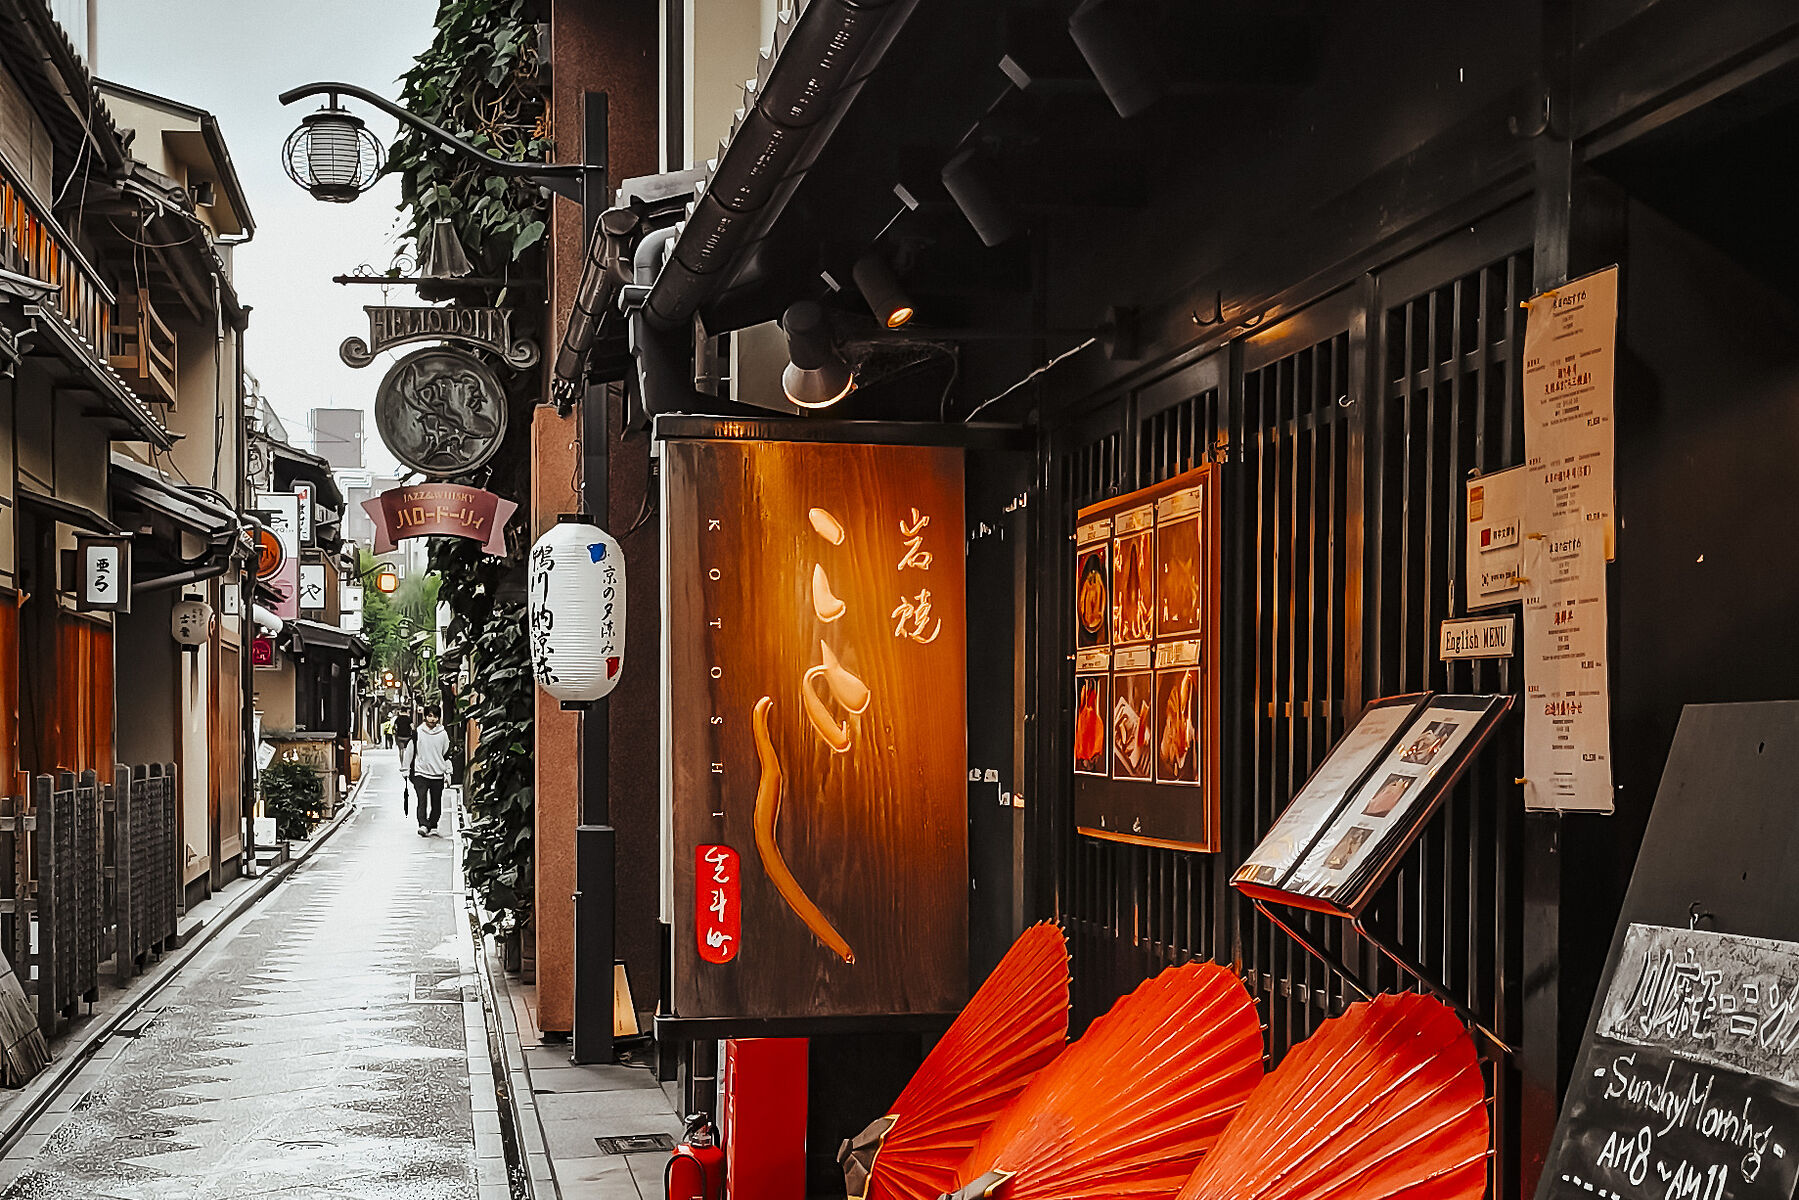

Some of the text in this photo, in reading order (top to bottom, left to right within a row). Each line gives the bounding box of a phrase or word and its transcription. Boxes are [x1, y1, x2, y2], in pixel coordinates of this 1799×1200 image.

[708, 518, 725, 818] KOTOSHI
[1446, 625, 1507, 654] English MENU
